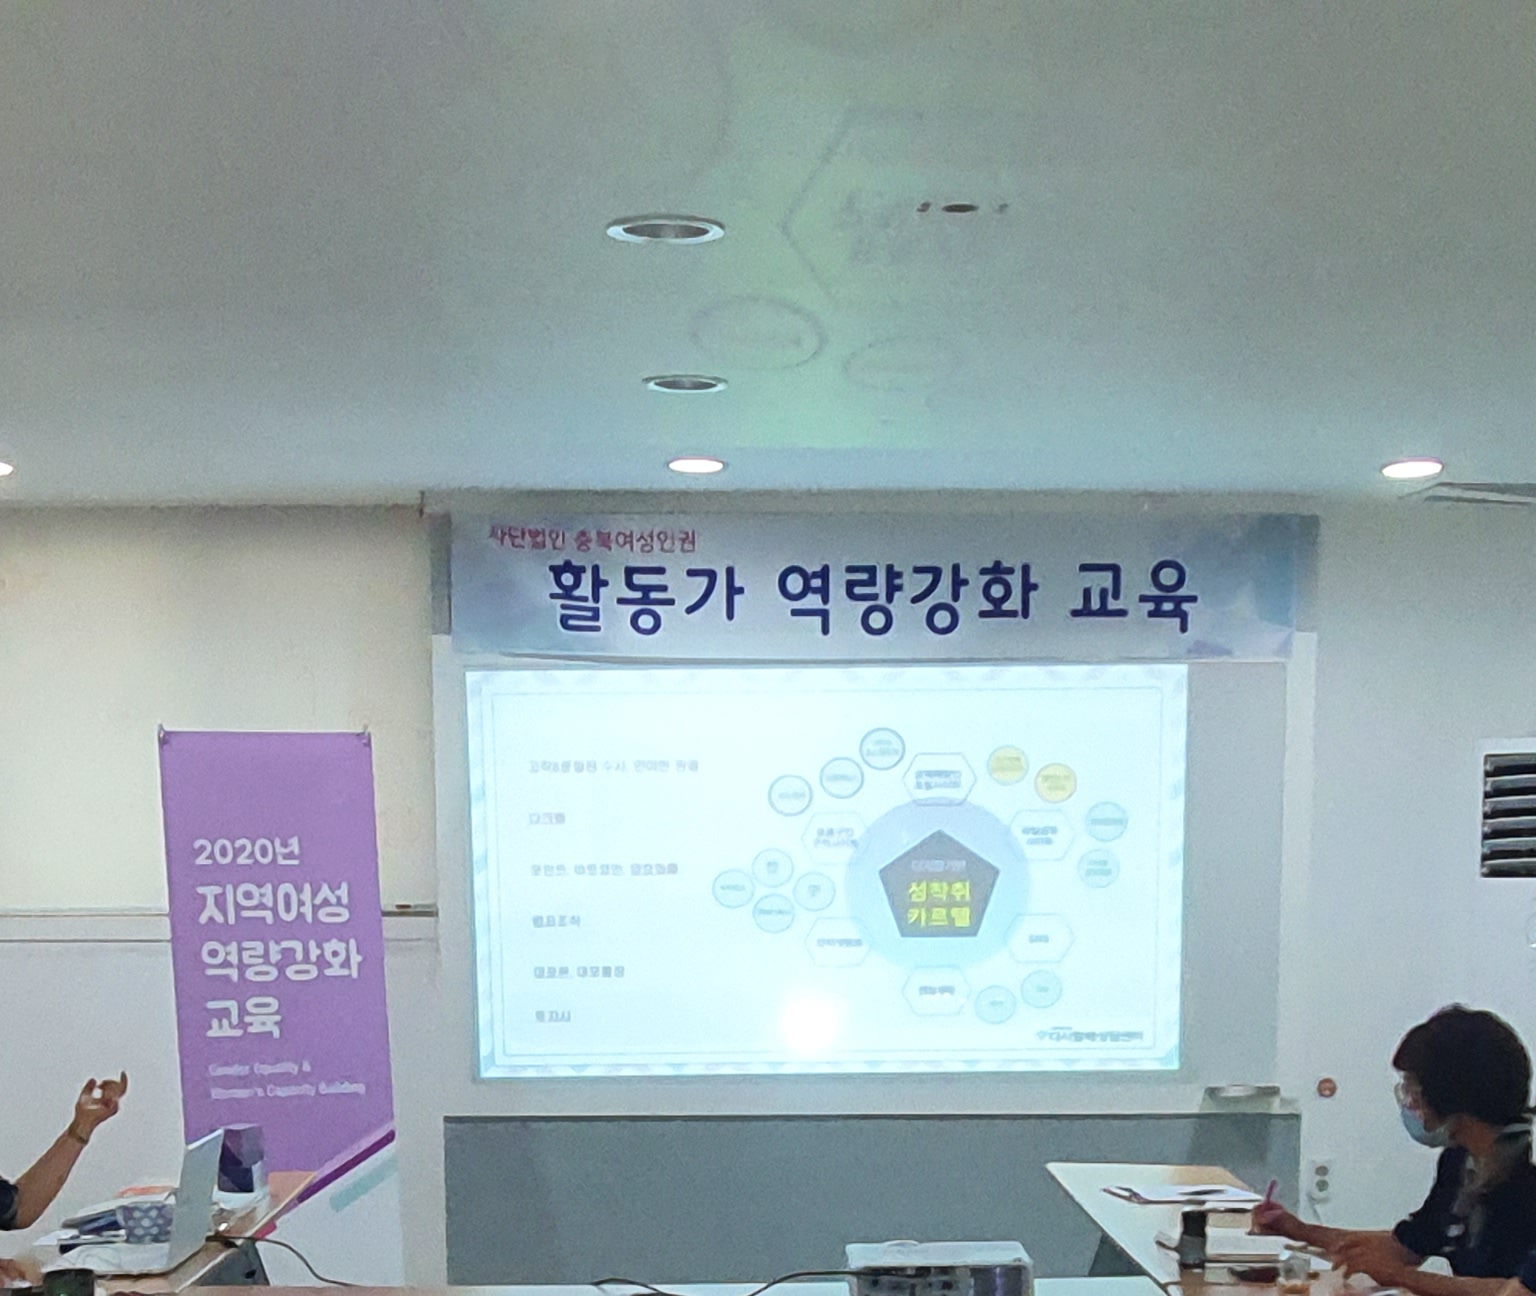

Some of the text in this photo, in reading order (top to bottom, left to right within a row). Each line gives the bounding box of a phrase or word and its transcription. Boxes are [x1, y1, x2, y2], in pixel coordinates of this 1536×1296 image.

[489, 524, 696, 553] 사단법인 충북여성인권
[549, 558, 1199, 636] 활동가 역량강화 교육
[193, 835, 300, 866] 2020년
[195, 881, 350, 926] 지역여성
[908, 879, 971, 902] 성착취
[907, 906, 971, 930] 카르텔
[200, 937, 364, 983] 역량강화
[205, 995, 283, 1040] 교육
